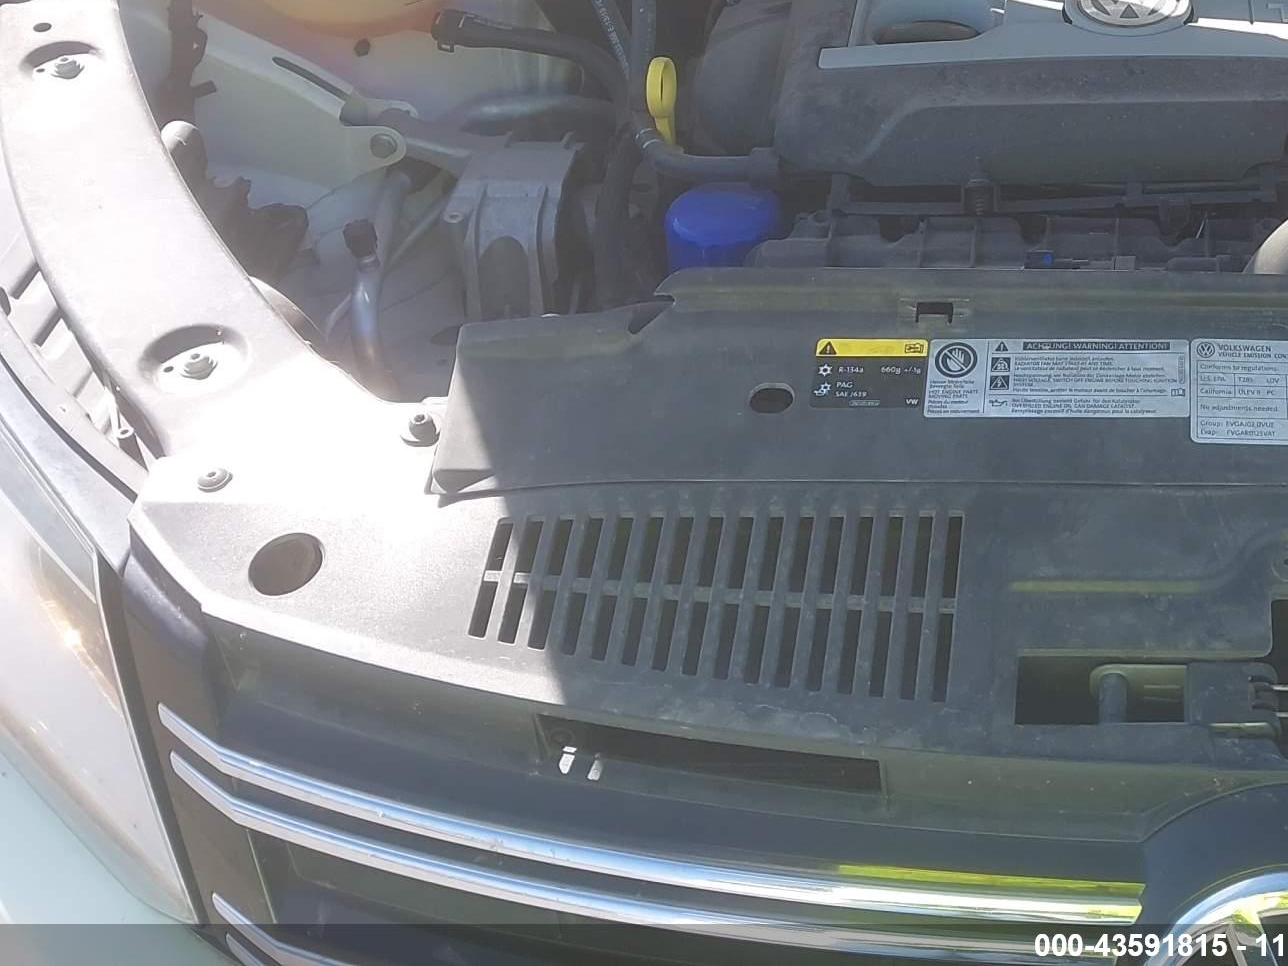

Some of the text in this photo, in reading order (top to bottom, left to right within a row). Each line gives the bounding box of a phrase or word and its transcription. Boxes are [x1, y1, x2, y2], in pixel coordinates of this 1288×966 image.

[1073, 343, 1117, 351] WARNING!
[1118, 343, 1168, 351] ATTENTION!
[1217, 344, 1272, 352] VOLKSWAGEN
